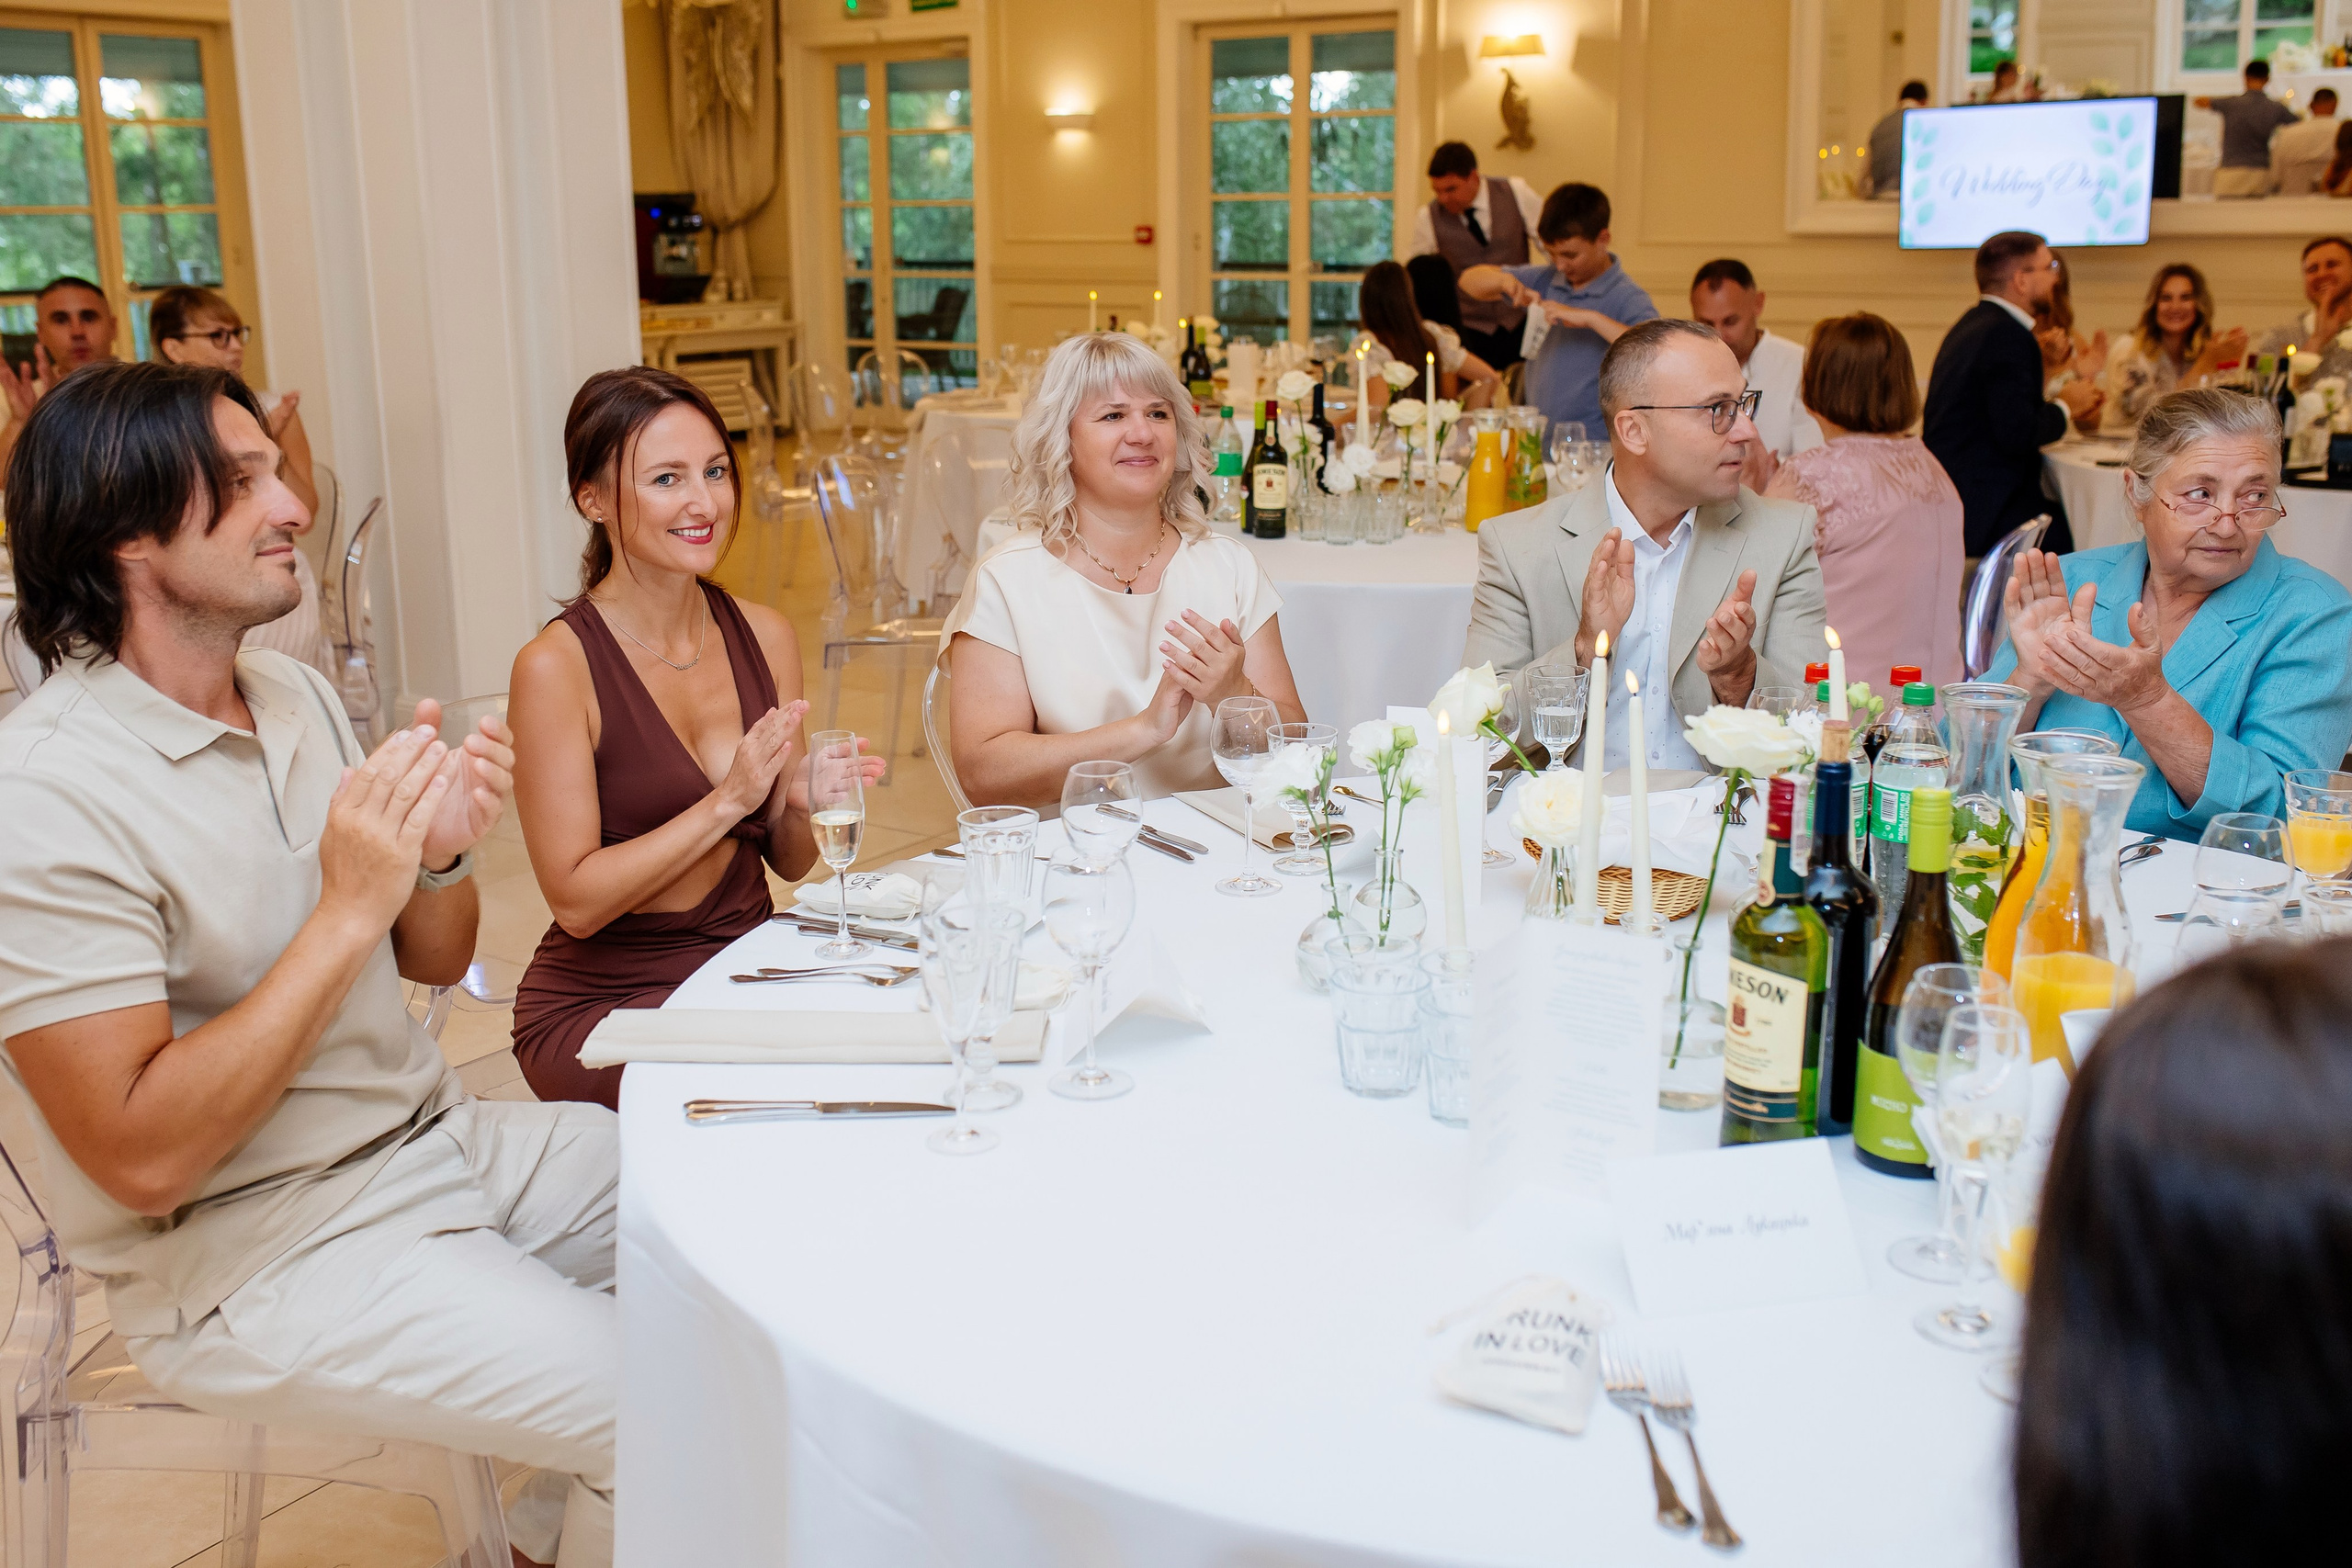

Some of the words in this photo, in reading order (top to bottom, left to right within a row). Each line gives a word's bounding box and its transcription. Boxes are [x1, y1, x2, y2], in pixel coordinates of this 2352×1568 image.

[1939, 162, 2045, 209] Wedding
[2046, 158, 2109, 207] Day
[1730, 968, 1789, 1005] ESON
[1473, 1331, 1508, 1350] IN
[1511, 1333, 1587, 1370] LOVE
